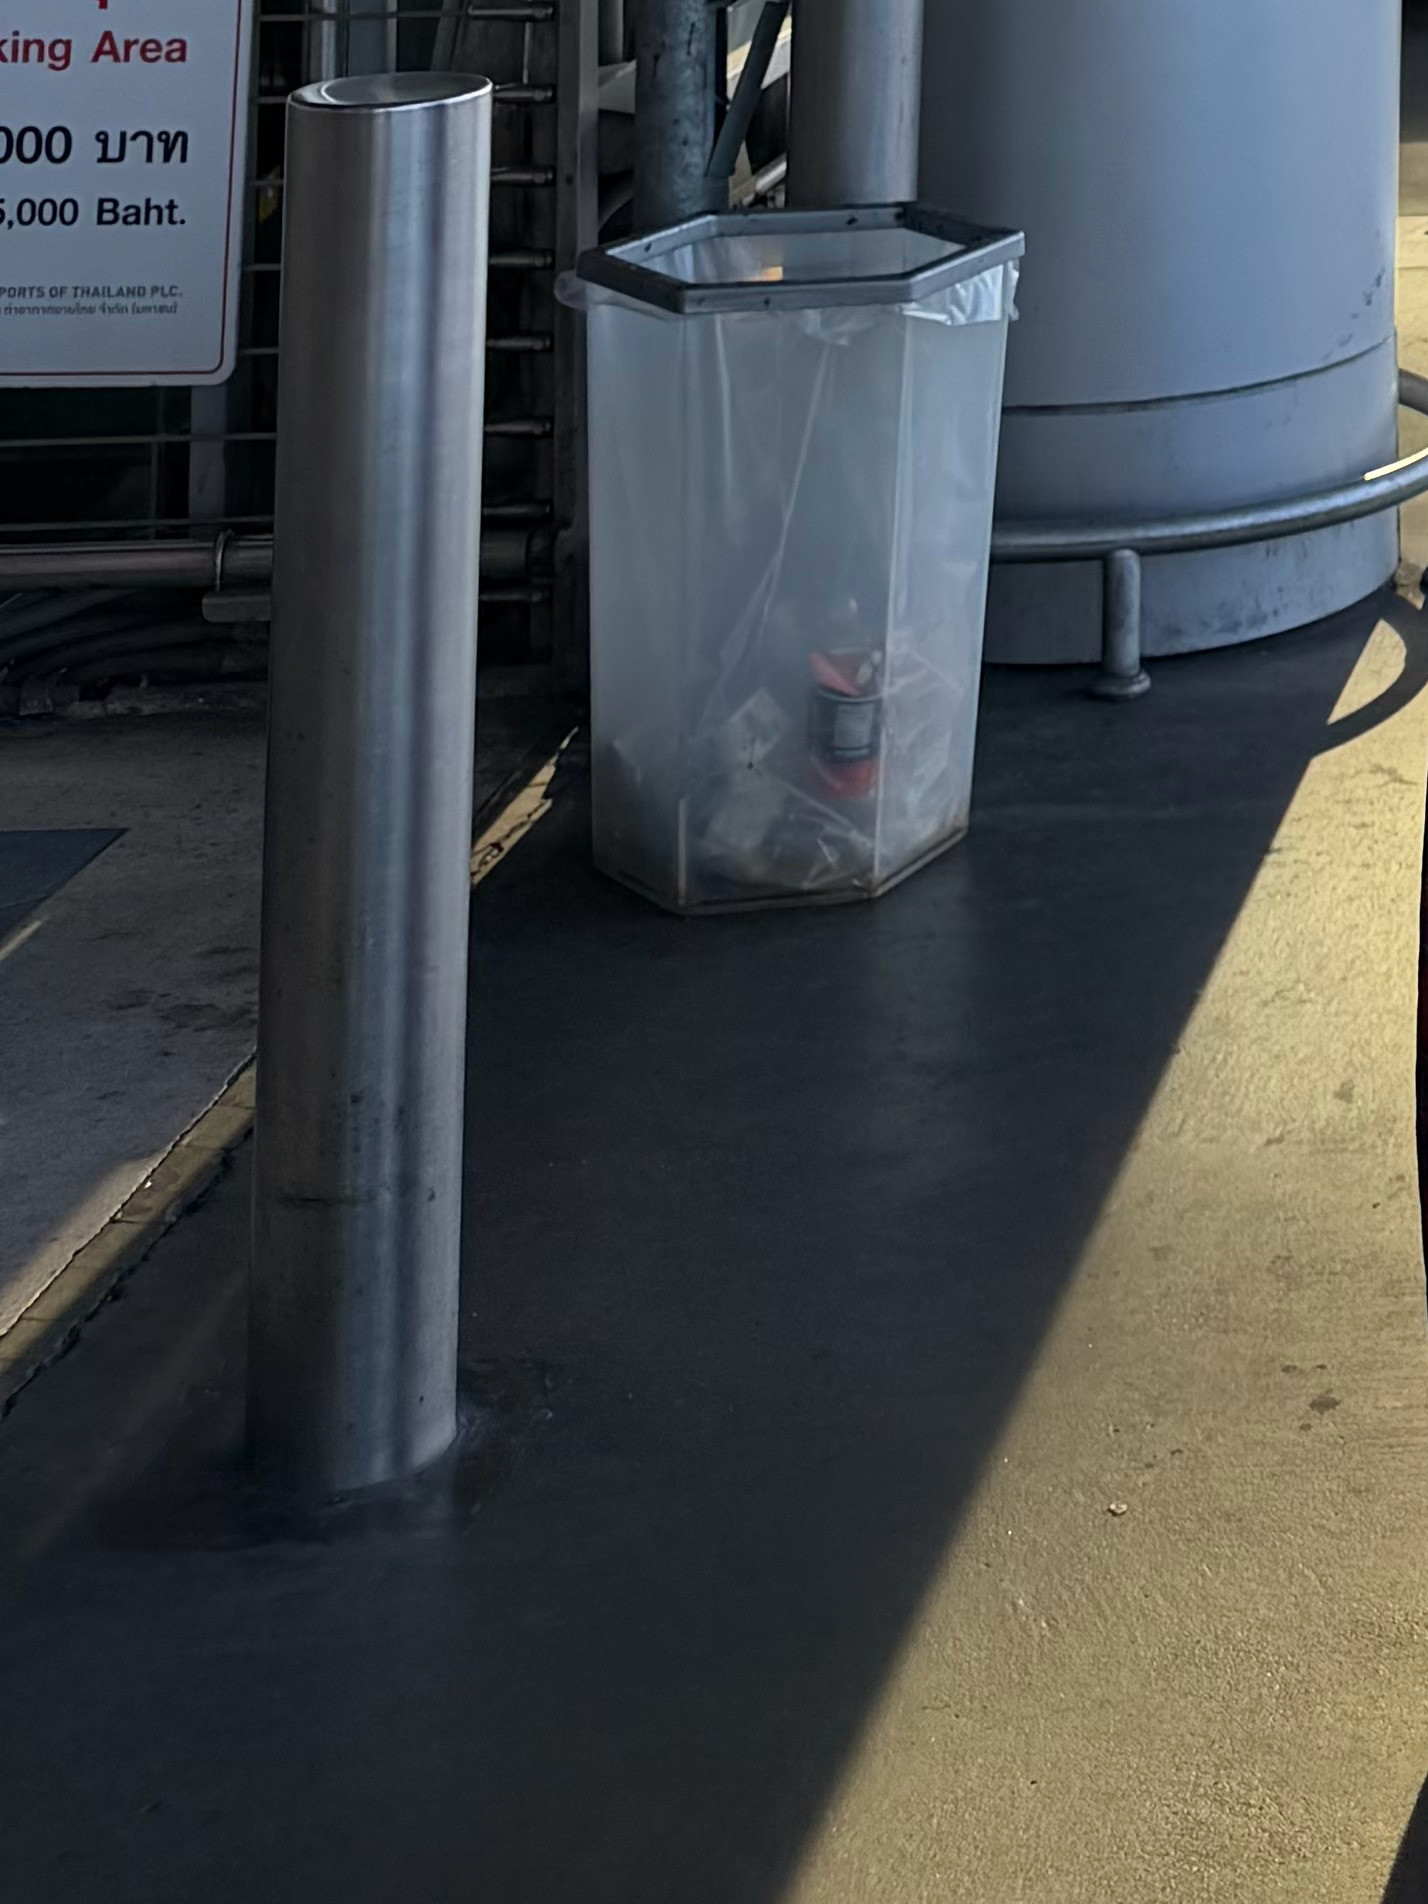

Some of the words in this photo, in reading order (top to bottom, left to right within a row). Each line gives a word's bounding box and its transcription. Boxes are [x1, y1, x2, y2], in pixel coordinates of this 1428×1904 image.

[91, 30, 187, 63] Area
[95, 130, 188, 164] บาท
[0, 198, 79, 229] ,000
[96, 197, 186, 226] Baht.
[49, 286, 67, 299] OF
[73, 286, 146, 299] THAILAND
[150, 286, 183, 299] PLC.
